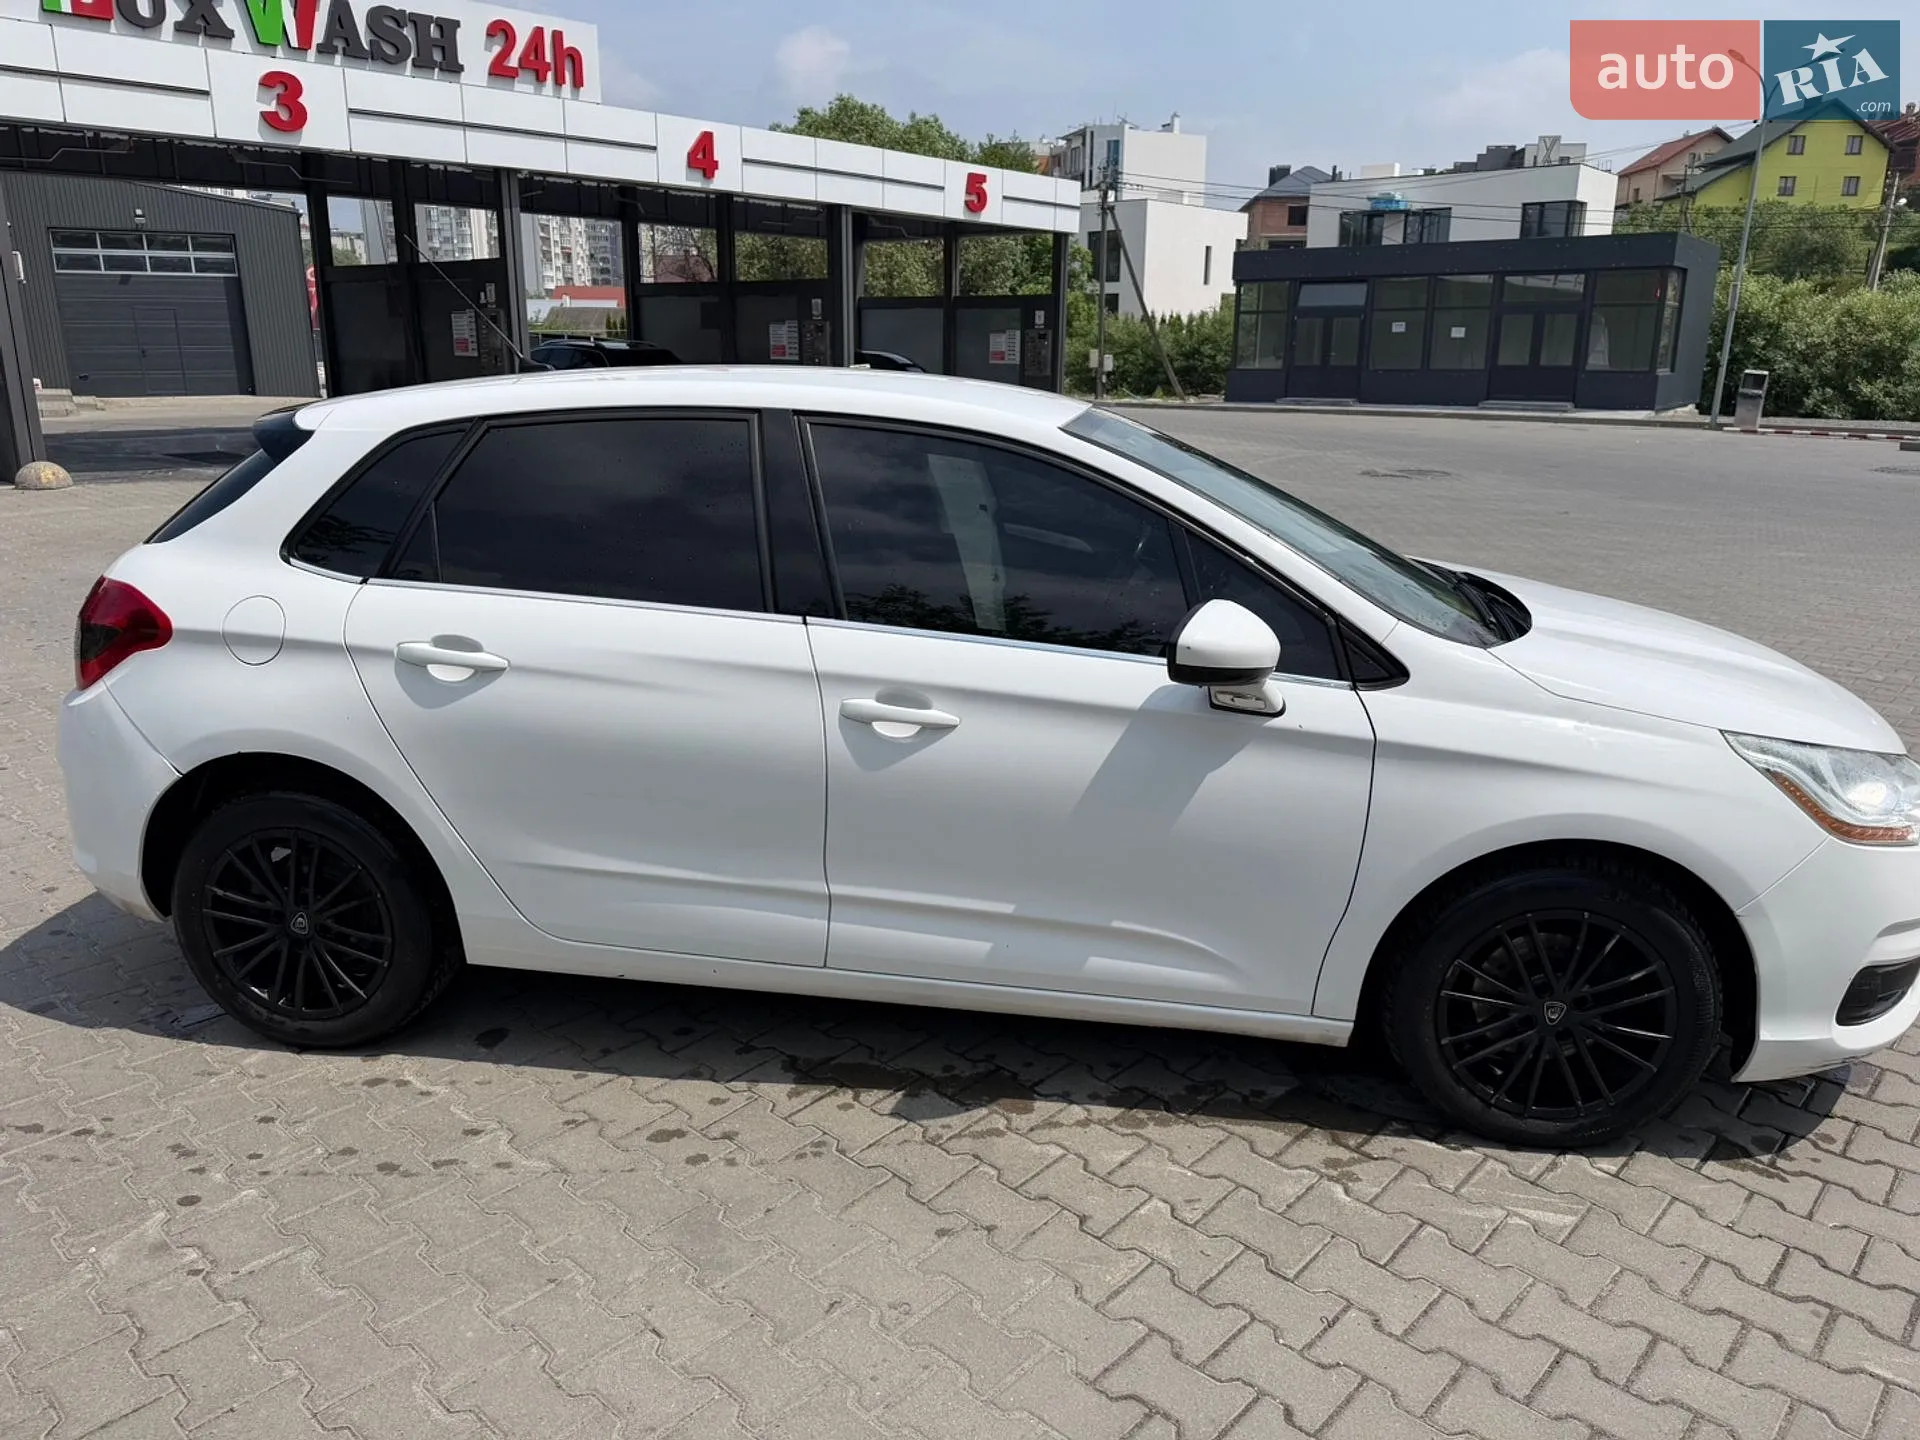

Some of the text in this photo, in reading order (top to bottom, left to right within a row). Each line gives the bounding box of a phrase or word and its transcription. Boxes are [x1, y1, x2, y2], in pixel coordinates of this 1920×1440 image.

[42, 0, 584, 88] UXWASH 24h
[258, 70, 308, 132] 3
[686, 131, 719, 180] 4
[964, 172, 989, 214] 5
